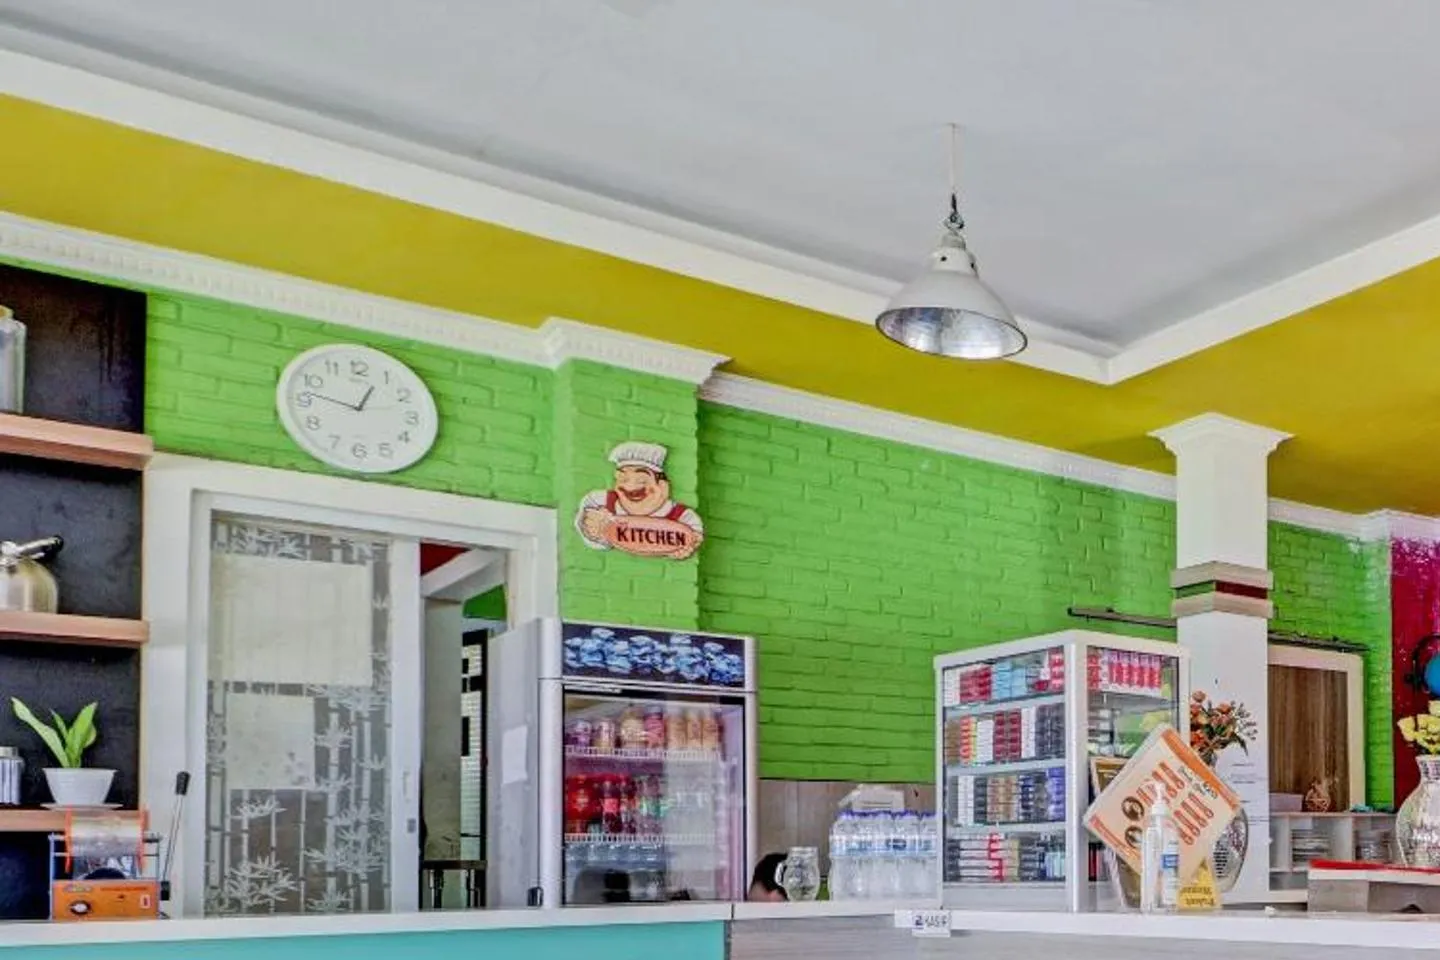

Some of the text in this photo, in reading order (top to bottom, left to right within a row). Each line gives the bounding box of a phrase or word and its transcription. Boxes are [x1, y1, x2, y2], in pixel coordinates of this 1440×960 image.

[325, 359, 339, 376] 11
[350, 360, 369, 377] 12
[304, 374, 324, 389] 10
[397, 388, 412, 403] 2
[306, 416, 321, 430] 8
[405, 411, 419, 425] 3
[328, 435, 341, 449] 7
[398, 431, 411, 444] 4
[352, 444, 367, 459] 6
[378, 443, 393, 458] 5
[617, 526, 686, 546] KITCHEN
